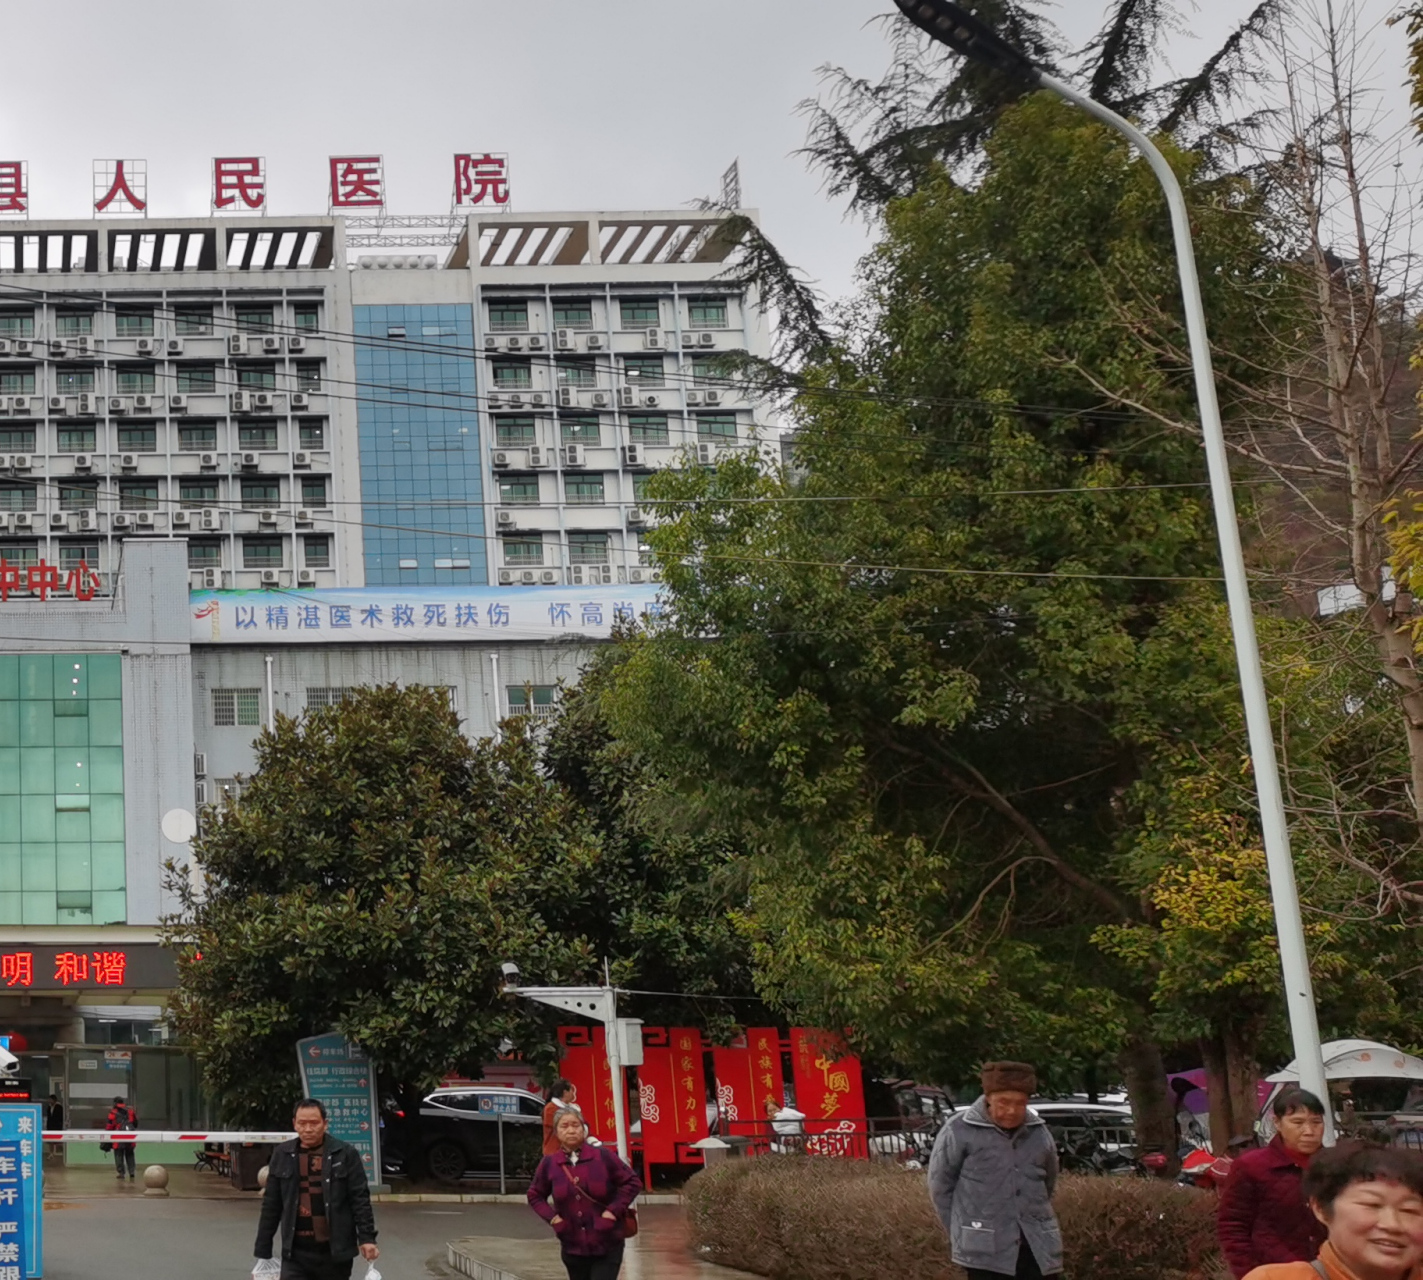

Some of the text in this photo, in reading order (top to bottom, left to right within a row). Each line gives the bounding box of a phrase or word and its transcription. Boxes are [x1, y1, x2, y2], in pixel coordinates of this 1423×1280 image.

[235, 603, 510, 629] 以精湛医术救死扶伤
[54, 951, 126, 985] 和谐
